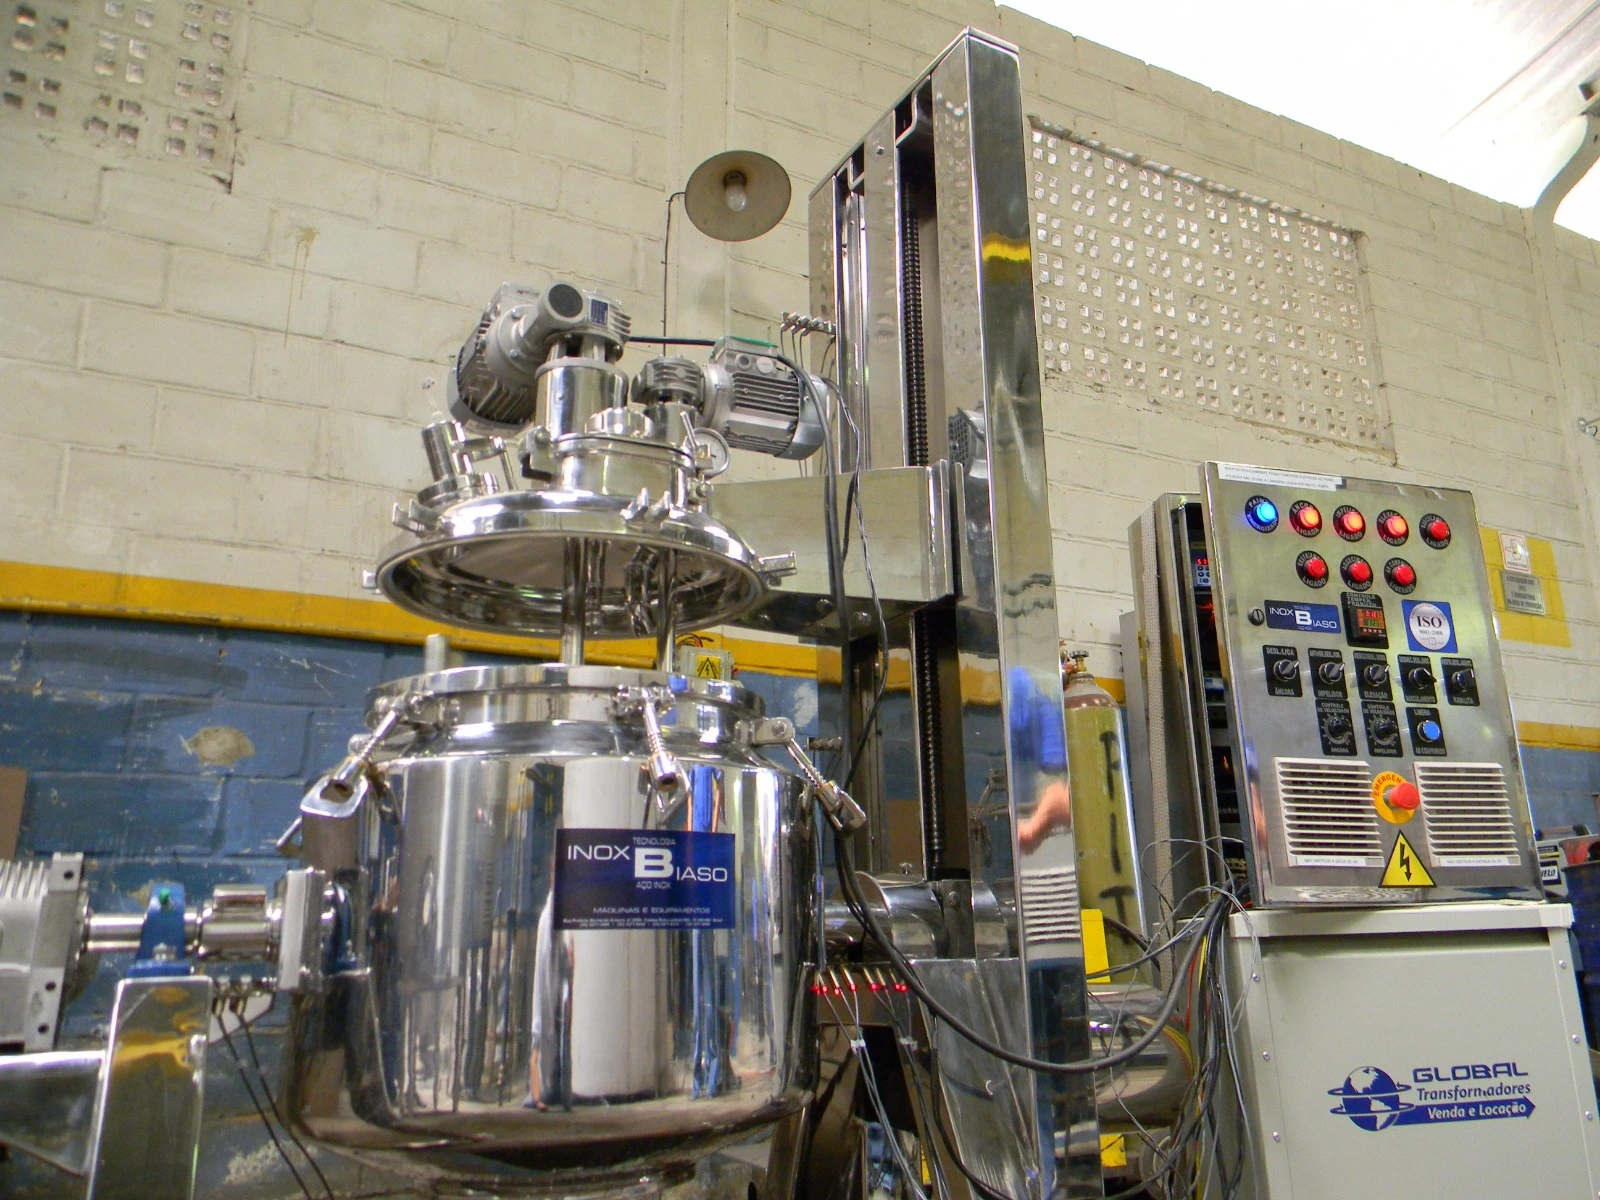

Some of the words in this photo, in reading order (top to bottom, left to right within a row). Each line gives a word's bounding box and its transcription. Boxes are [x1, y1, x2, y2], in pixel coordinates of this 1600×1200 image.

[1296, 526, 1320, 536] LIGADA
[1340, 530, 1363, 540] LIGADO
[1302, 576, 1326, 588] LIGADO
[1269, 607, 1294, 616] INOX
[1416, 616, 1442, 628] ISO
[632, 837, 676, 846] TECNOLOGIA
[567, 845, 630, 860] INOX
[636, 881, 652, 890] AÇO
[653, 881, 671, 889] INOX
[1412, 1062, 1529, 1083] GLOBAL
[1416, 1082, 1531, 1101] Transformadores
[1427, 1105, 1466, 1120] Venda
[1469, 1107, 1475, 1116] e
[1479, 1101, 1526, 1117] Locação
